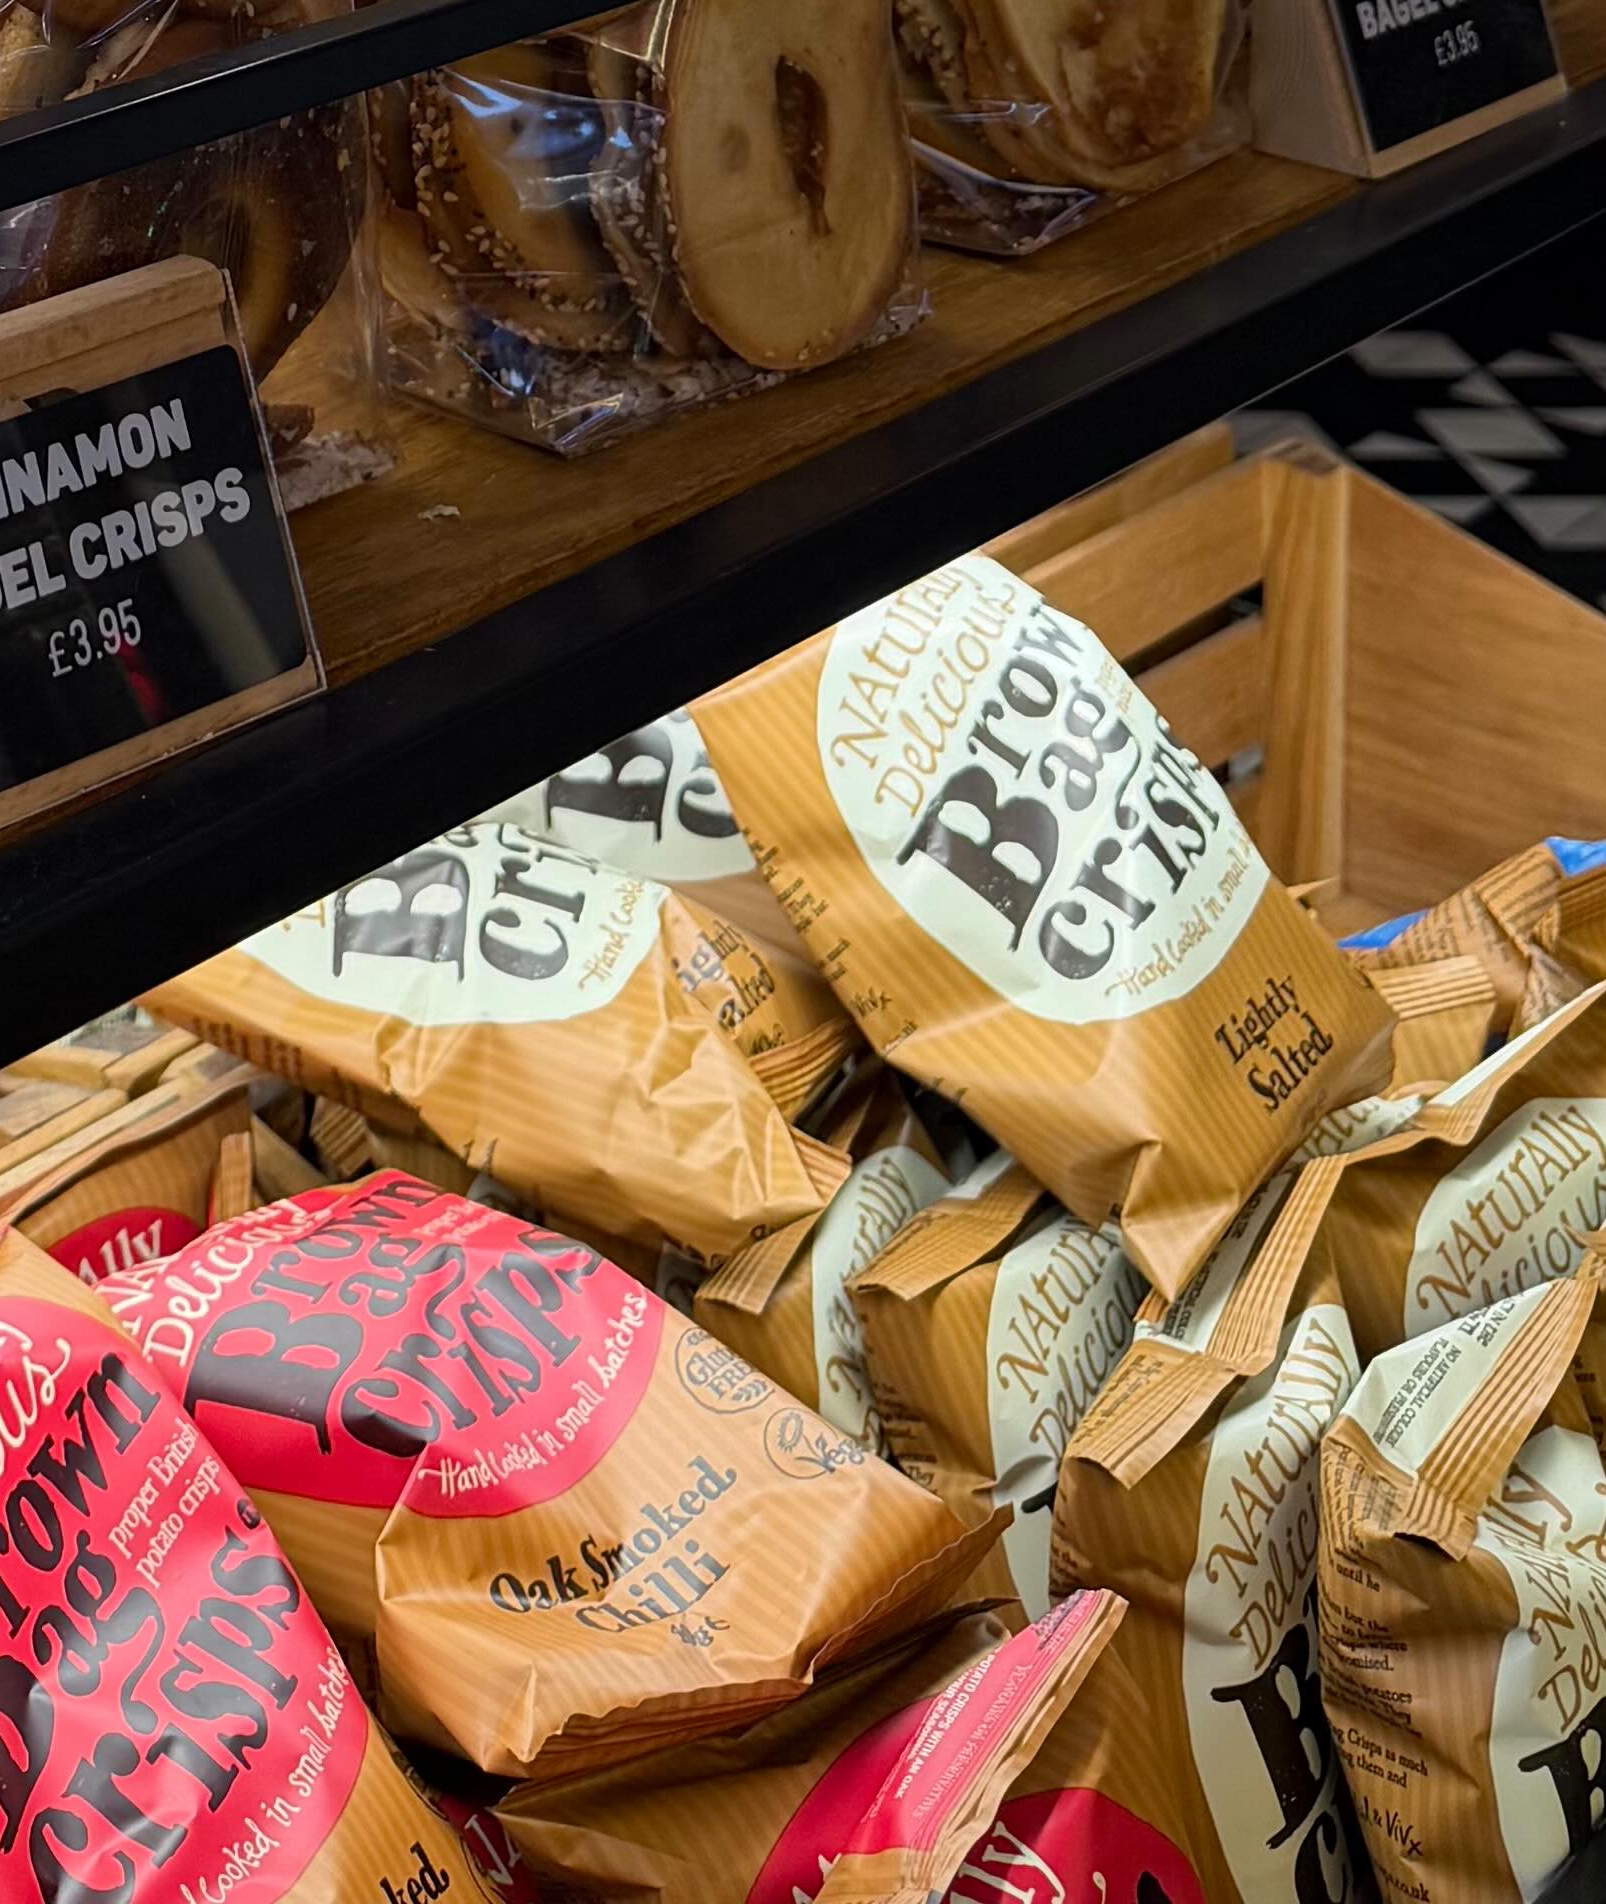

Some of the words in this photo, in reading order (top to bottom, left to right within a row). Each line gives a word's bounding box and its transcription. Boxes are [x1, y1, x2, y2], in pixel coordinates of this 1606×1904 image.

[67, 467, 252, 581] CRISPS
[48, 597, 143, 678] £3.95
[1215, 975, 1301, 1065] Lightly
[1247, 1011, 1333, 1115] Salted
[418, 1449, 498, 1498] Hand
[555, 1380, 605, 1441] small
[588, 1290, 648, 1389] batches
[109, 1476, 160, 1560] proper
[152, 1420, 200, 1492] British
[135, 1507, 187, 1589] potato
[178, 1453, 221, 1524] crisps
[490, 1556, 589, 1613] Oak
[579, 1455, 738, 1594] Smoked
[575, 1539, 731, 1633] Chilli
[938, 1693, 971, 1729] CRISPS
[965, 1655, 994, 1692] POTATO
[265, 1792, 299, 1831] in
[287, 1725, 333, 1796] small
[920, 1731, 945, 1758] WITH
[1348, 1728, 1383, 1759] Crisps
[1399, 1753, 1429, 1777] much
[1357, 1753, 1385, 1779] them
[1387, 1771, 1408, 1789] and
